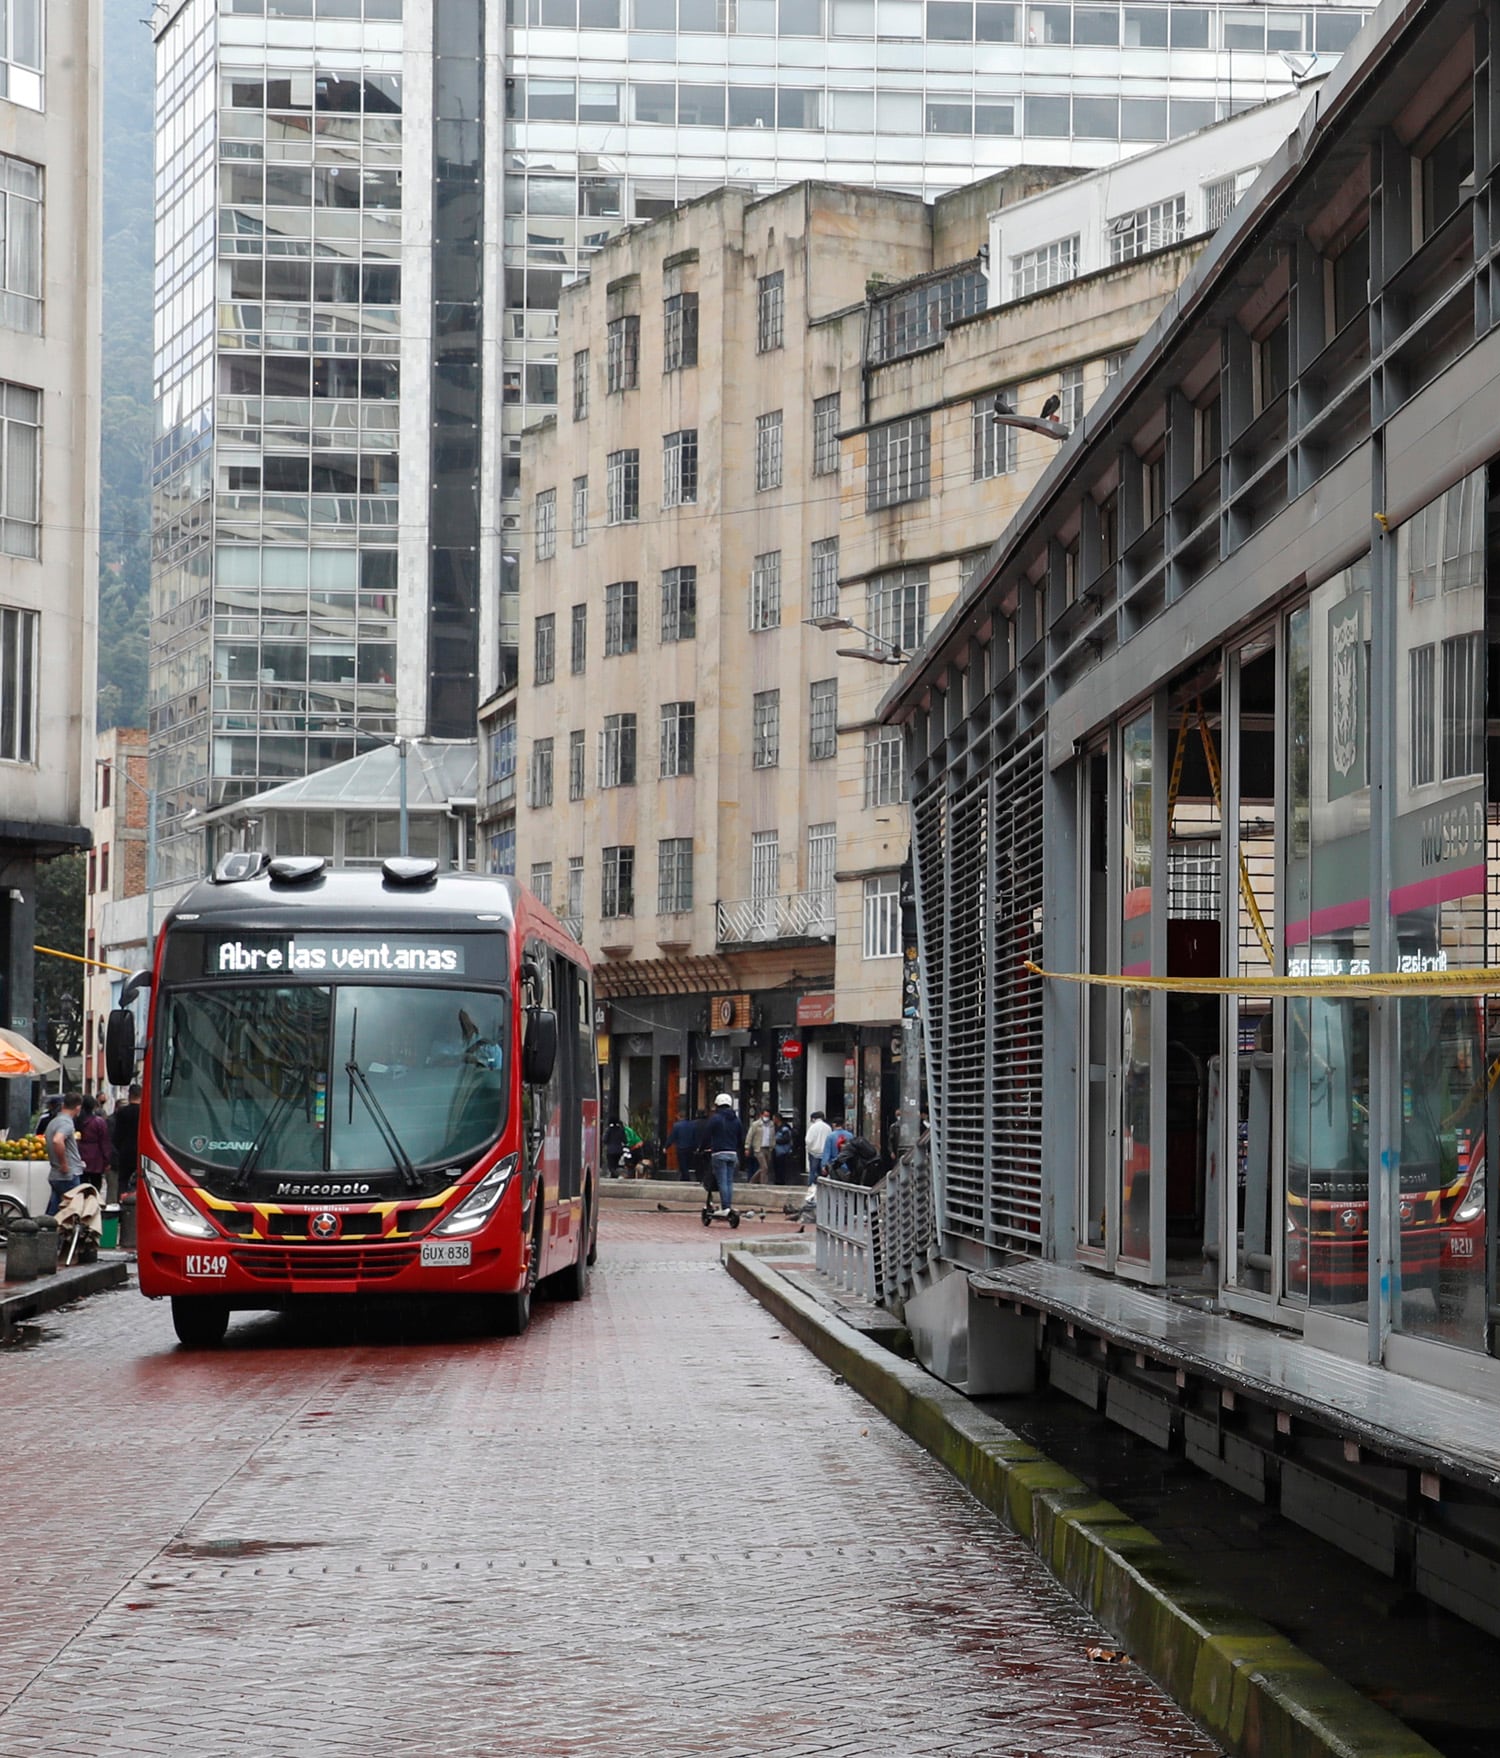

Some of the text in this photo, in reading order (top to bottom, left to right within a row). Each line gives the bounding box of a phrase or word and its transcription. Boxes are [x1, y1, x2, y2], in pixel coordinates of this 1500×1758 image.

[1421, 806, 1469, 868] MUSEO
[219, 940, 457, 970] Abre las ventanas
[277, 1182, 370, 1196] Marcopolo
[422, 1245, 470, 1260] GUX 838
[186, 1255, 228, 1275] K1549
